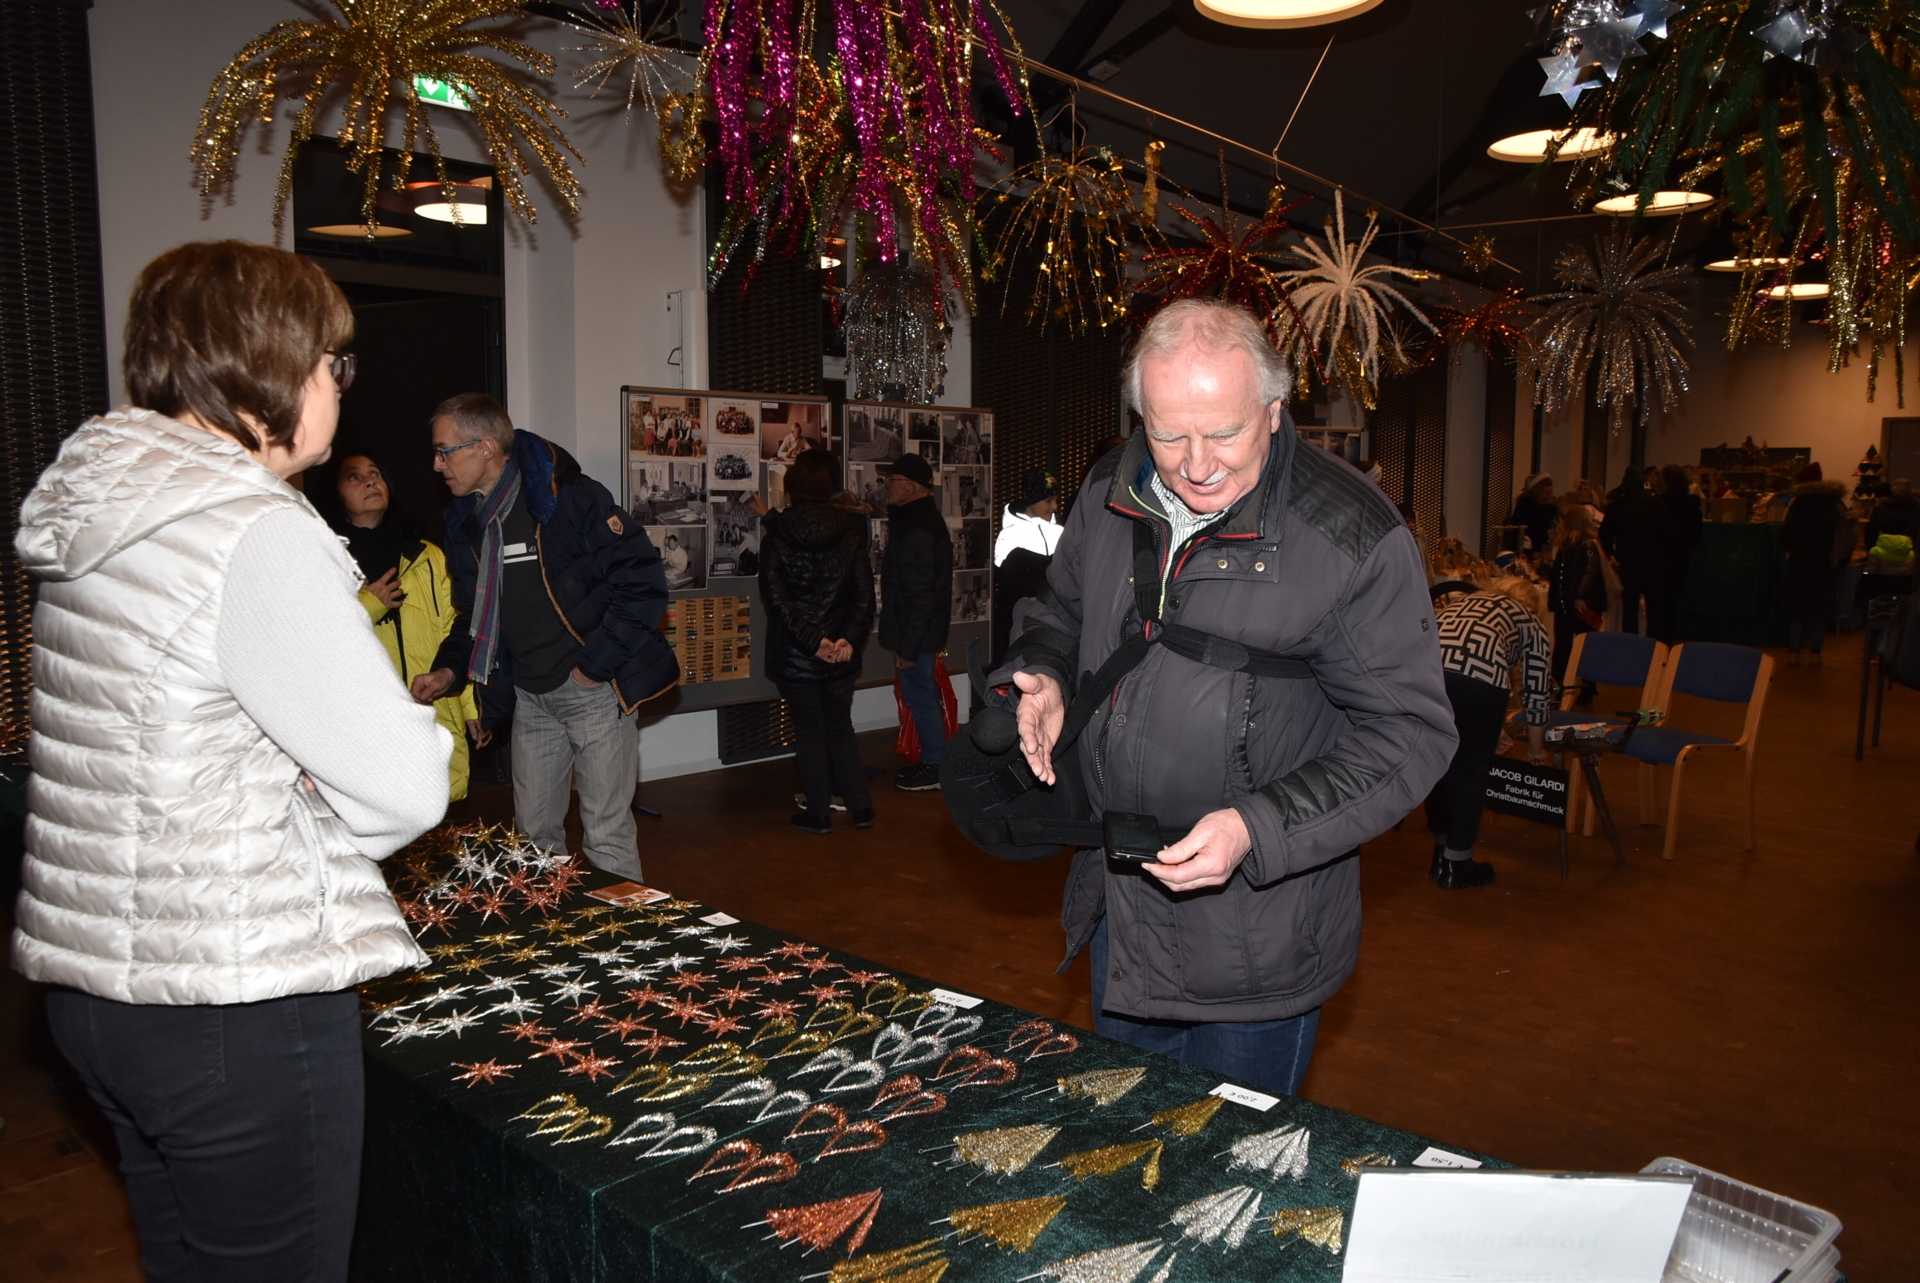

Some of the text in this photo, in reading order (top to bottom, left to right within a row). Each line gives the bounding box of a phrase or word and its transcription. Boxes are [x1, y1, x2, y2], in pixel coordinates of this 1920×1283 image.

[1489, 767, 1565, 792] JACOB GILARDI
[1505, 784, 1544, 800] Fabrik für
[1486, 788, 1564, 815] Christbaumschmuck
